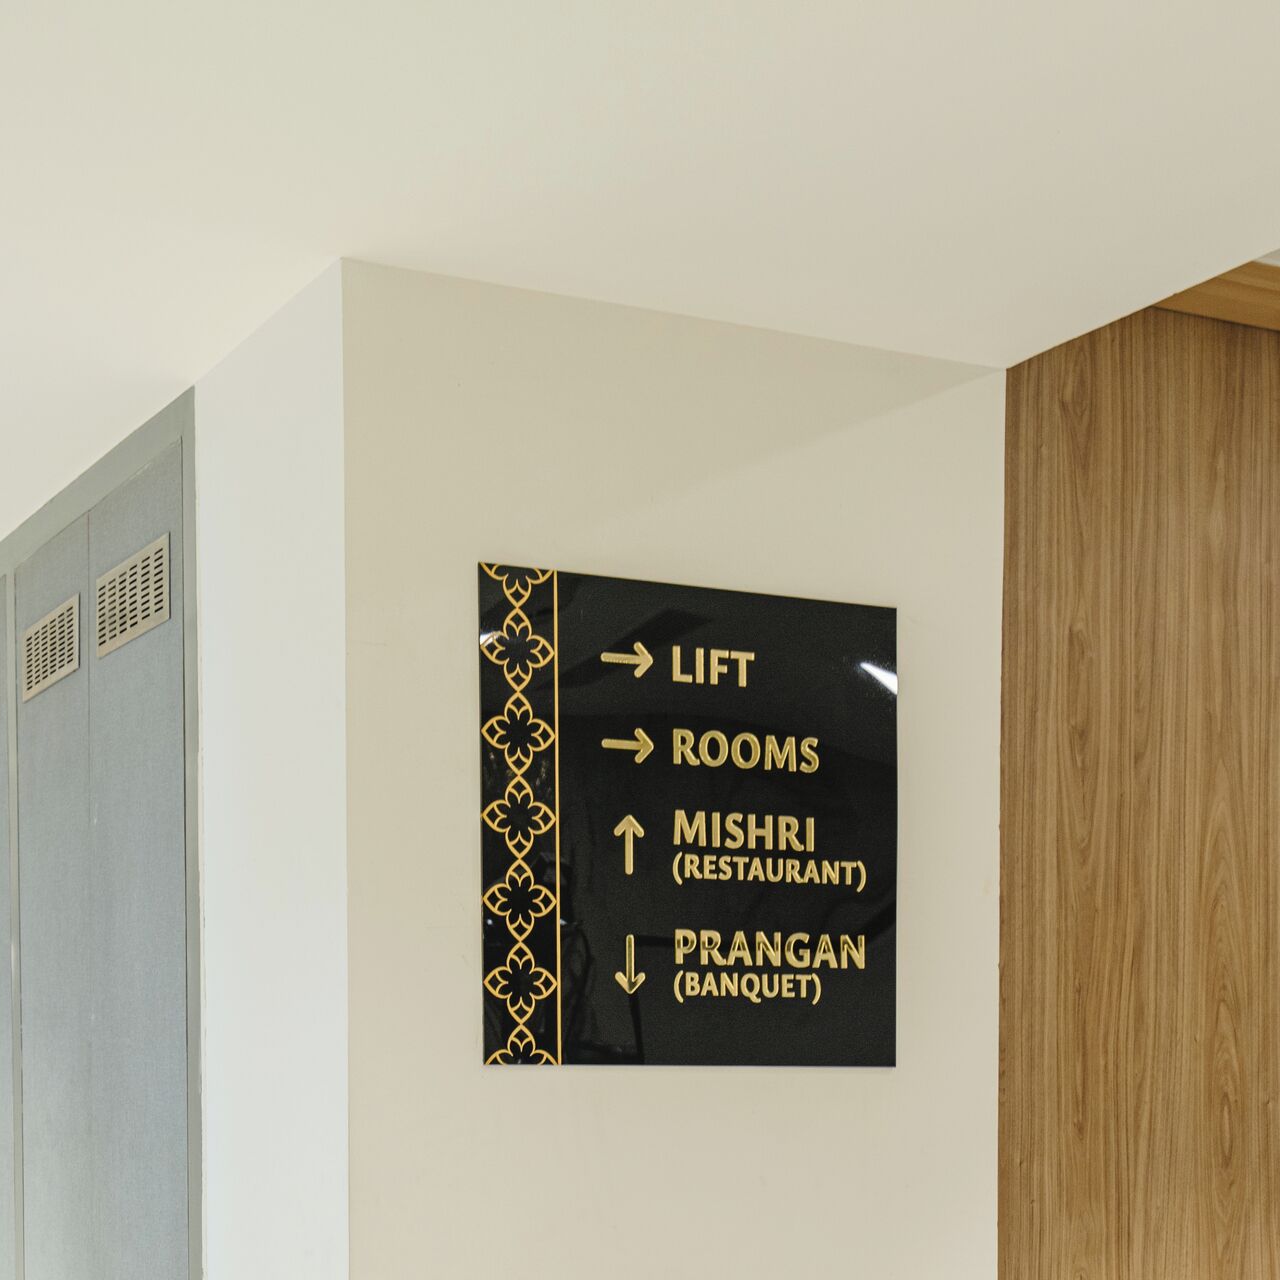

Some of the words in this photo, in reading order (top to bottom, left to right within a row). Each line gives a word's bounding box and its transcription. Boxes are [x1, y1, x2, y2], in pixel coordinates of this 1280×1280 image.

[672, 645, 755, 687] LIFT
[673, 729, 819, 773] ROOMS
[673, 809, 815, 853] MISHRI
[672, 852, 867, 892] (RESTAURANT)
[674, 929, 866, 970] PRANGAN
[674, 970, 822, 1005] (BANQUET)
